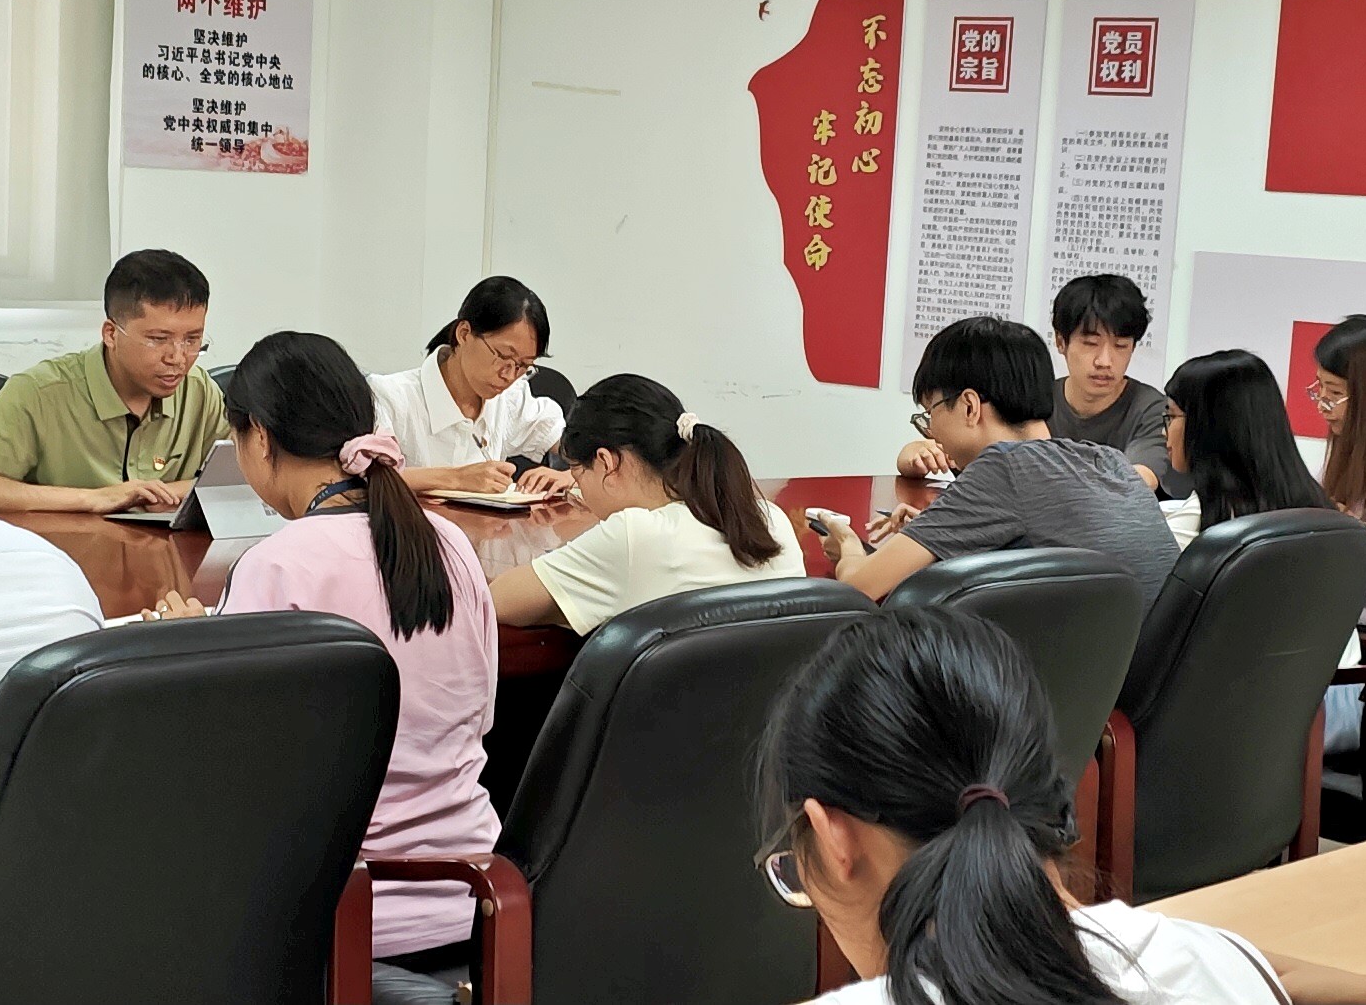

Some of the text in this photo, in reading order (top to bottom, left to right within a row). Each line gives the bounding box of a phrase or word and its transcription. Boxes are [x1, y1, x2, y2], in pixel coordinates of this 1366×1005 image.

[193, 28, 248, 47] 坚决维护
[961, 28, 1001, 54] 党的
[1101, 31, 1143, 55] 党员
[157, 45, 281, 70] 习近平总书记党中央
[958, 56, 999, 81] 宗旨
[142, 63, 294, 91] 的核心、全党的核心地位
[1099, 59, 1142, 83] 权利
[851, 14, 888, 174] 不忘初心
[192, 98, 247, 115] 坚决维护
[163, 115, 273, 138] 党中央权威和集中
[190, 136, 245, 155] 统一领导
[803, 110, 838, 271] 牢记使命
